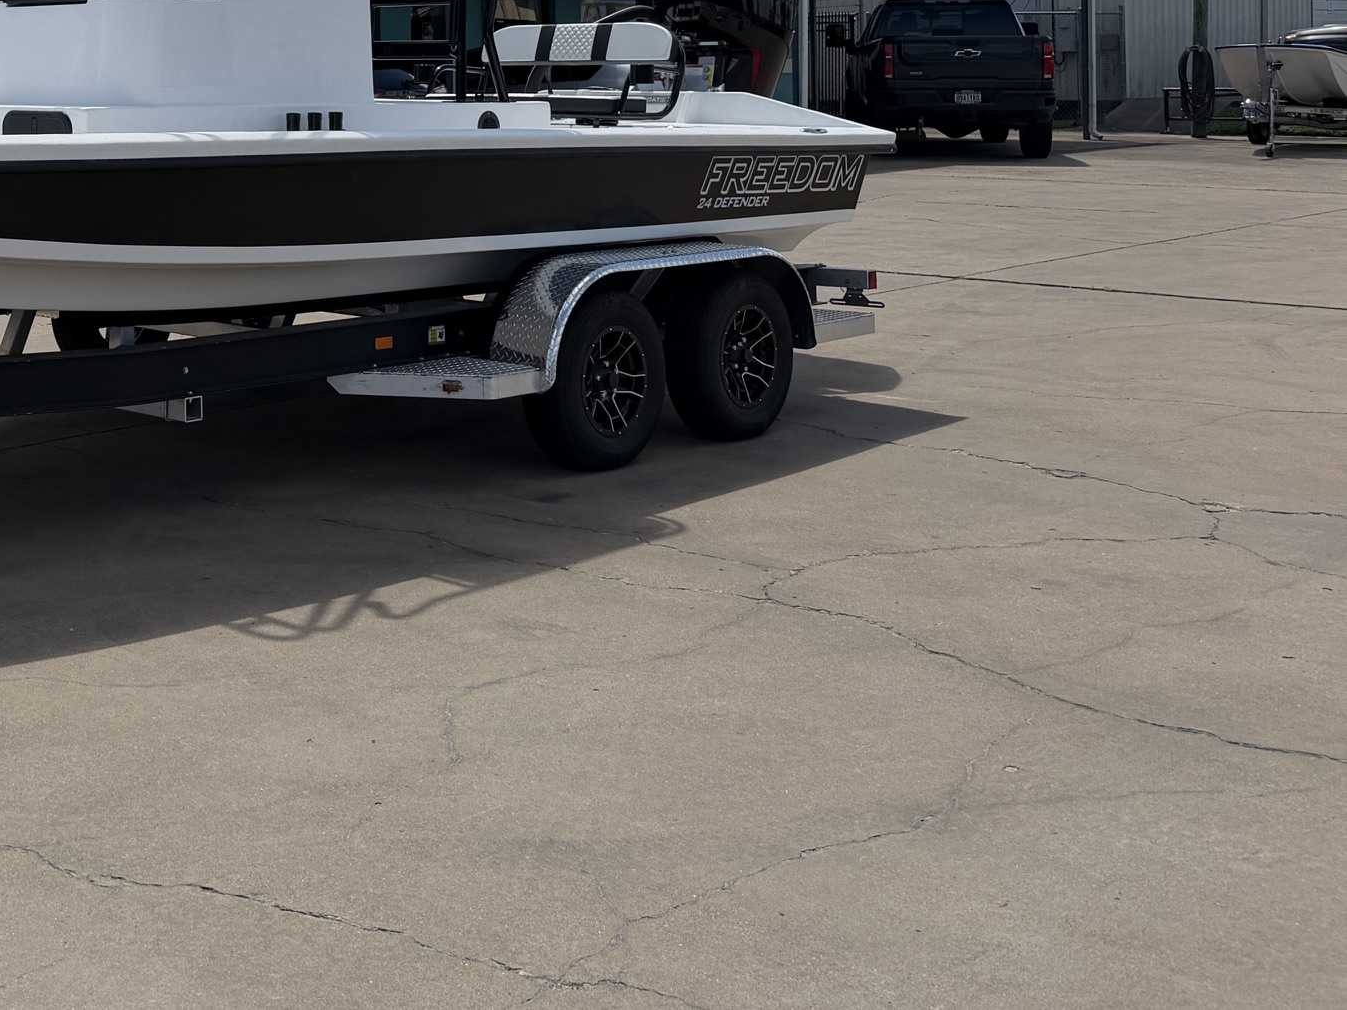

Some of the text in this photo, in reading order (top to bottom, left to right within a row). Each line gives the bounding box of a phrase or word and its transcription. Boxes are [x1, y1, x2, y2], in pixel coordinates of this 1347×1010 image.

[700, 154, 865, 195] FREEDOM
[697, 195, 770, 209] 24 DEFENDER
